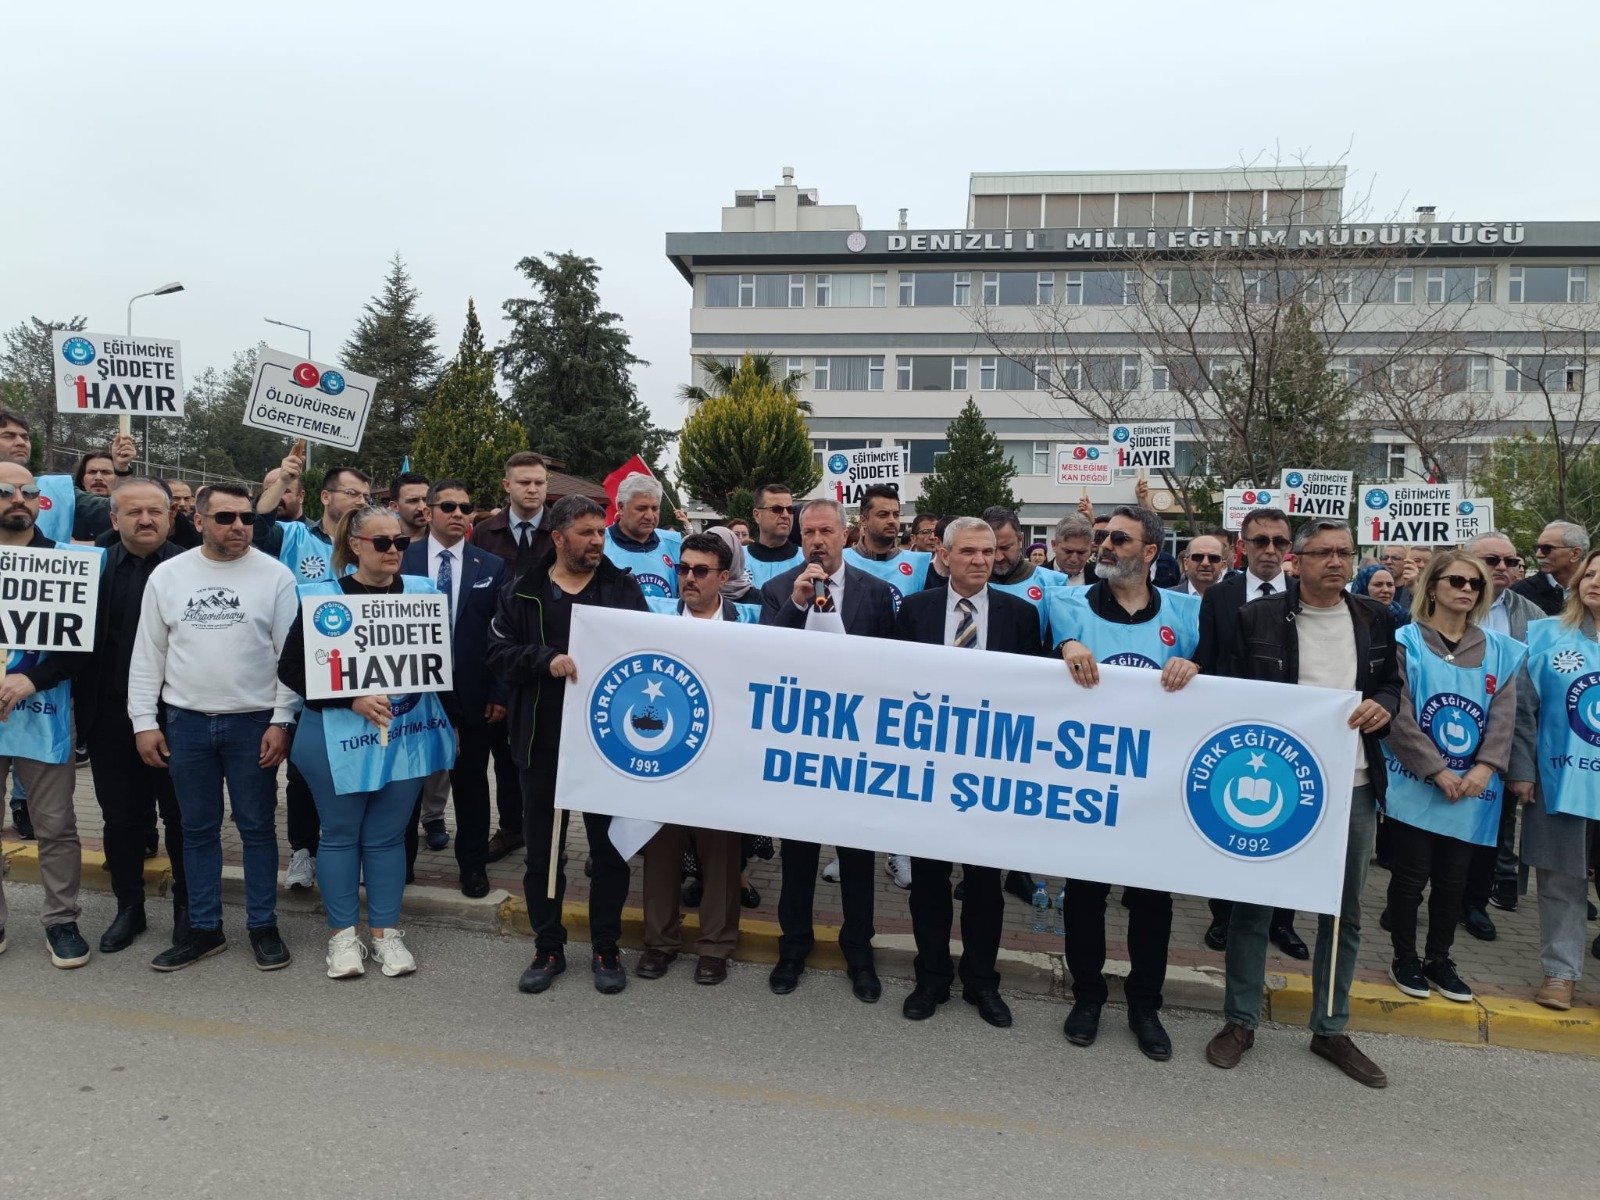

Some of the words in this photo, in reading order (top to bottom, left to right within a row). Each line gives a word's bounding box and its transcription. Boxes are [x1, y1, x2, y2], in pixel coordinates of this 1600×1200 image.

[888, 230, 1013, 251] DENİZLİ
[1066, 228, 1156, 249] MİLLİ
[1168, 227, 1287, 248] EĞİTİM
[1299, 222, 1525, 246] MÜDÜRLÜĞÜ
[103, 339, 175, 359] EĞİTİMCİYE
[96, 355, 176, 381] ŞİDDETE
[265, 386, 357, 422] ÖLDÜRÜRSEN
[256, 403, 350, 440] ÖĞRETEMEM...
[1129, 435, 1171, 451] ŞİDDETE
[852, 451, 899, 464] EĞİTİMCİYE
[848, 463, 900, 483] ŞİDDETE
[1302, 481, 1347, 497] ŞİDDETE
[1394, 487, 1451, 500] EĞİTİMCİYE
[1388, 499, 1451, 520] ŞİDDETE
[0, 551, 90, 576] ĞİTİMCİYE
[0, 571, 88, 605] DDETE
[361, 600, 441, 619] EĞİTİMCİYE
[354, 619, 443, 653] ŞİDDETE
[594, 659, 643, 739] TÜRKİYE
[1567, 680, 1588, 711] TÜRK
[1422, 700, 1441, 728] TÜRK
[748, 675, 864, 742] TÜRK
[875, 690, 1151, 779] EĞİTİM-SEN
[340, 732, 380, 752] TÜRK
[629, 756, 660, 773] 1992
[1193, 742, 1227, 792] TÜRK
[1229, 729, 1315, 807] EĞİTİM-SEN
[762, 747, 935, 803] DENİZLİ
[950, 772, 1120, 827] ŞUBESİ
[1228, 834, 1271, 852] 1992
